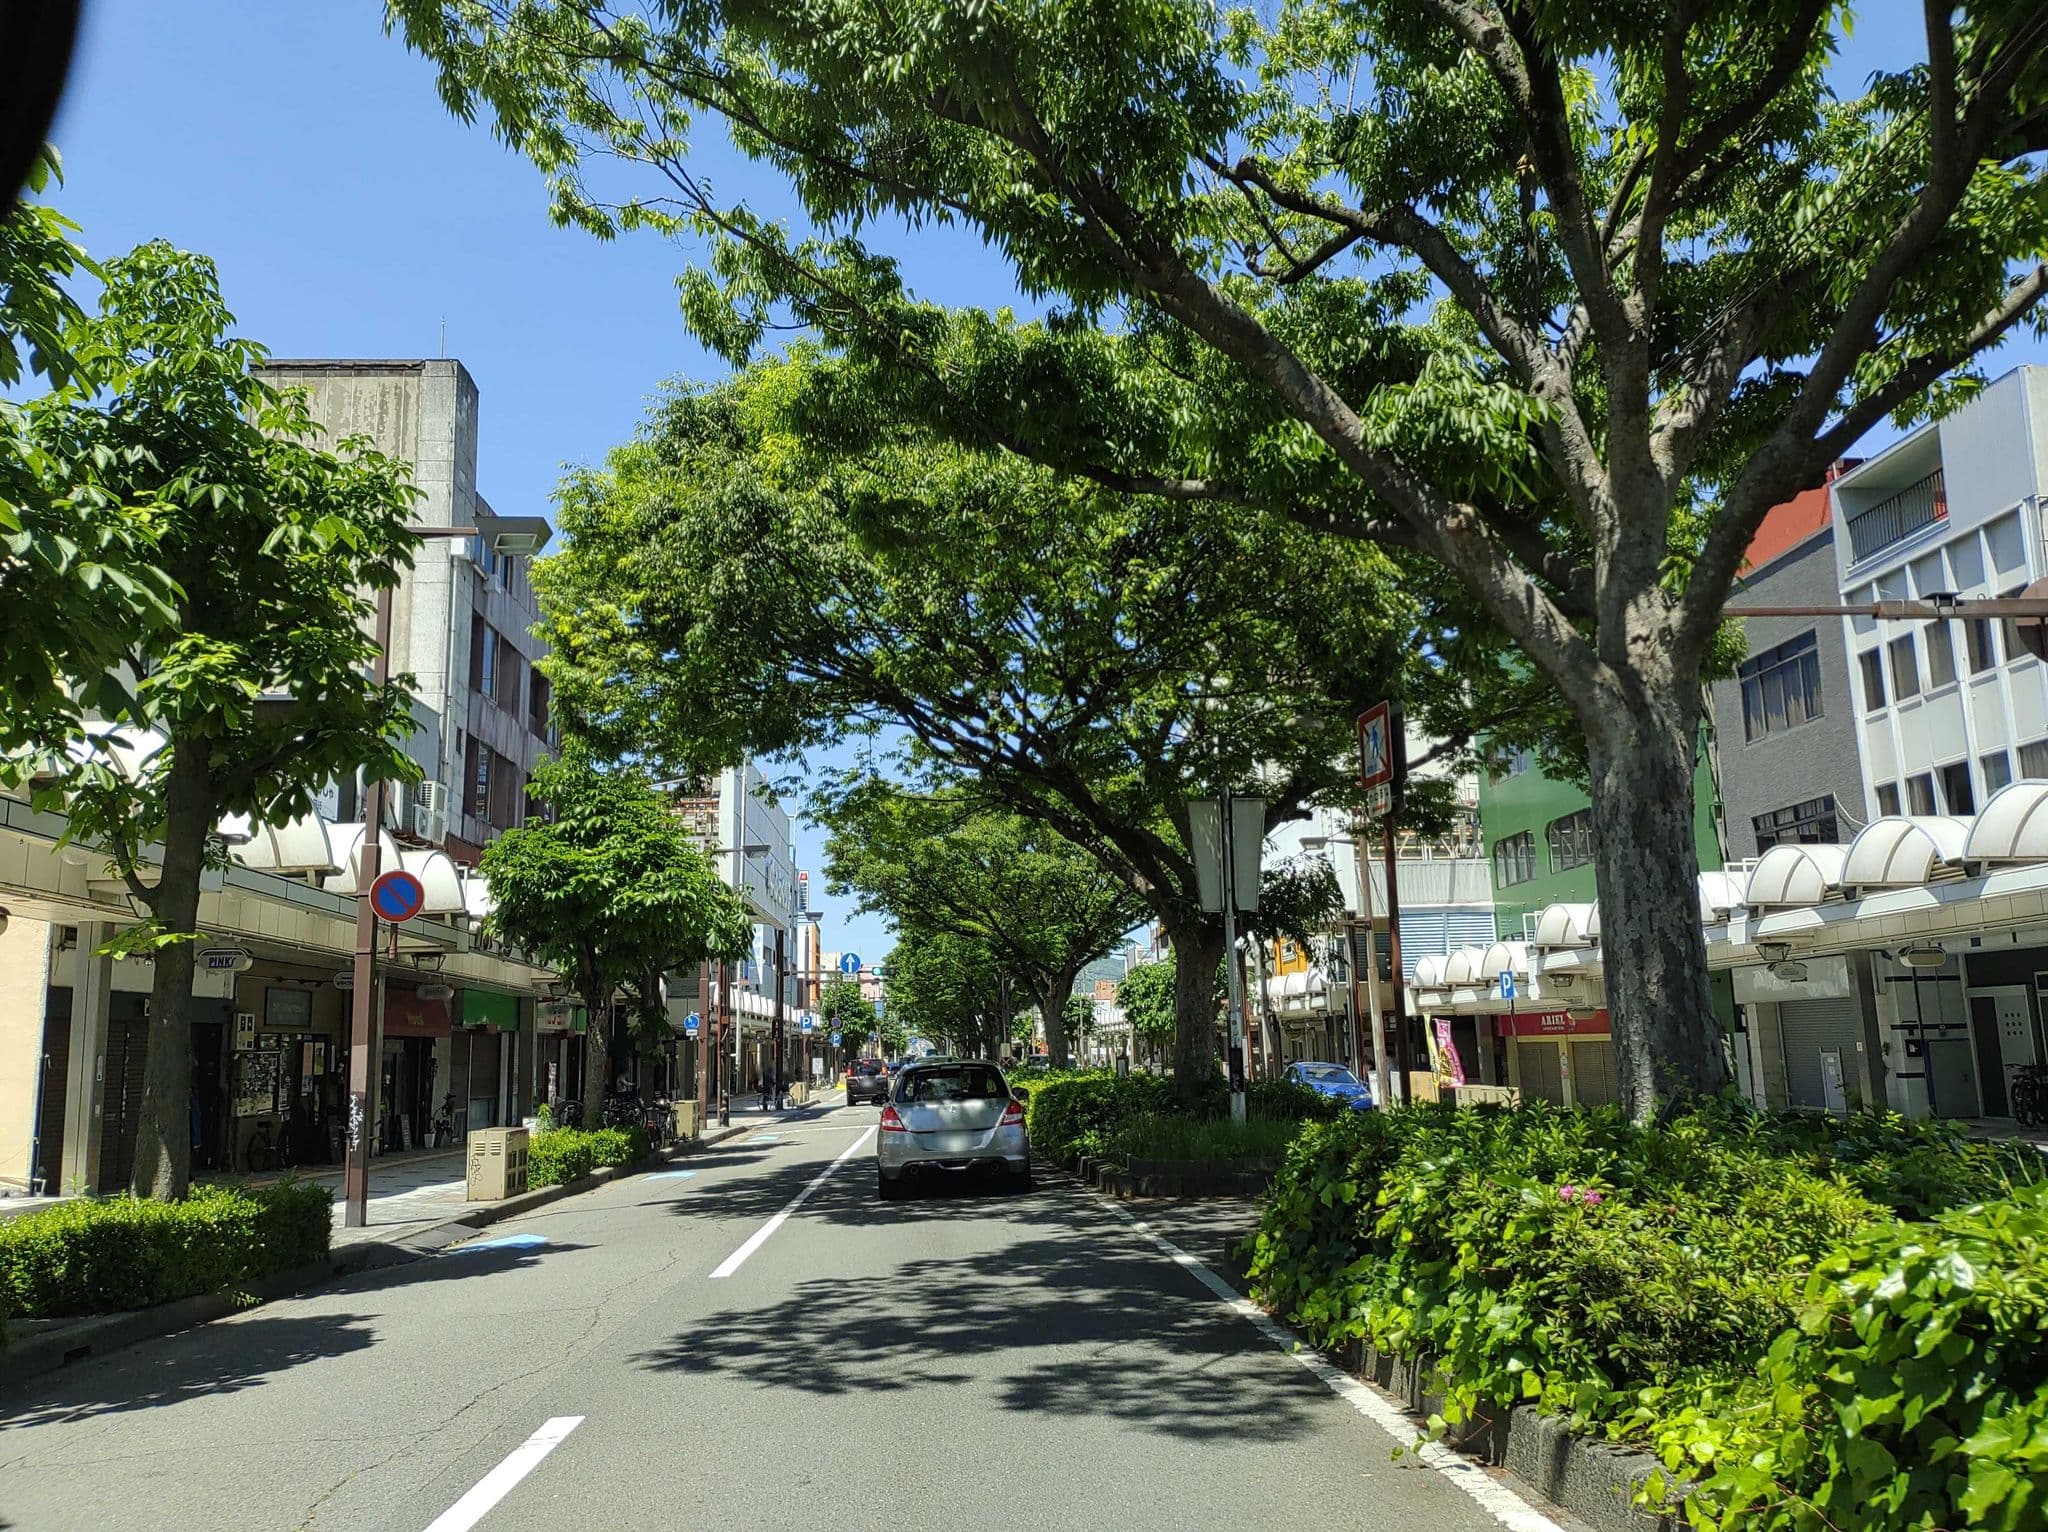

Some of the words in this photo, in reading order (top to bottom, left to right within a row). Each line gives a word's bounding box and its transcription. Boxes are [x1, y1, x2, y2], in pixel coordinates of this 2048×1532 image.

[1502, 973, 1511, 997] P
[802, 1017, 810, 1028] P
[1541, 1015, 1566, 1026] ARIEL
